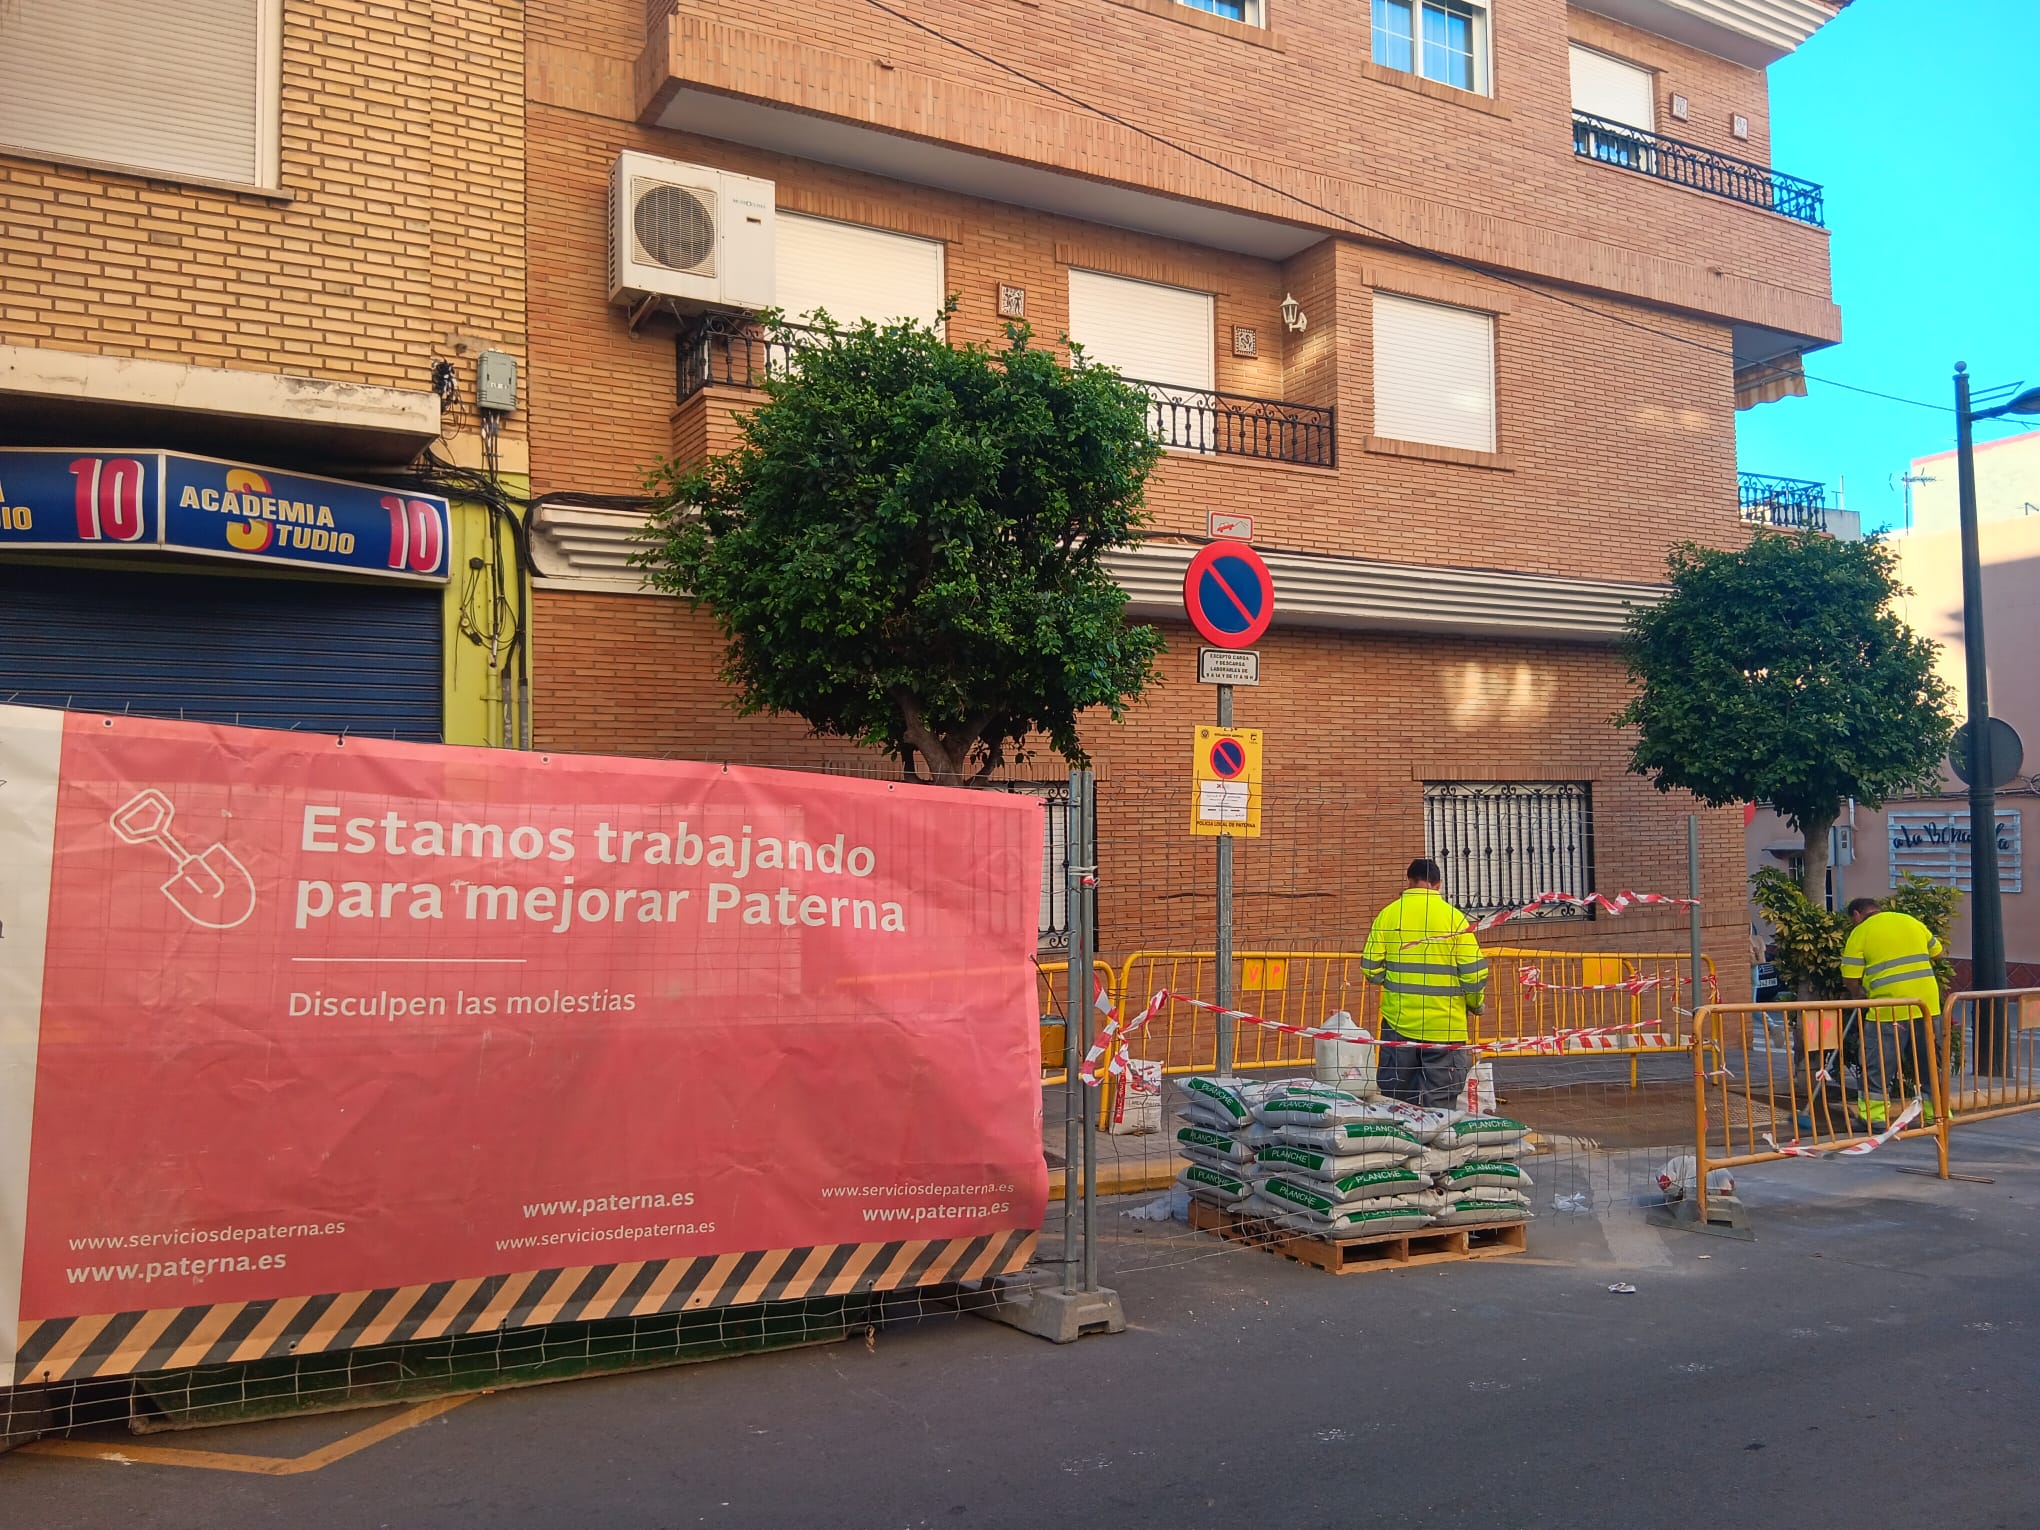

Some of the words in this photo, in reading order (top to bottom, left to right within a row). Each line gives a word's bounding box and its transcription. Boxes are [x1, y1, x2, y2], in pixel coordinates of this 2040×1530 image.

[69, 457, 144, 541] 10
[180, 486, 335, 528] ACADEMIA
[0, 506, 33, 530] IO
[380, 495, 443, 573] 10
[300, 804, 576, 862] Estamos
[594, 820, 877, 878] trabajando
[294, 876, 445, 930] para
[464, 876, 690, 934] mejorar
[706, 883, 906, 933] Paterna
[288, 992, 447, 1022] Disculpen
[456, 990, 498, 1016] las
[506, 989, 637, 1015] molestias
[1201, 1083, 1234, 1106] PLANCHE
[1278, 1101, 1315, 1110] PLANCHE
[1467, 1119, 1511, 1130] PLANCHE
[1271, 1149, 1309, 1163] PLANCHE
[818, 1182, 1015, 1198] www.serviciosdepaterna.es
[1356, 1170, 1402, 1184] PLANCHE
[521, 1191, 695, 1219] www.paterna.es
[1279, 1185, 1318, 1206] PLANCHE
[862, 1200, 1010, 1223] www.paterna.es
[69, 1219, 346, 1251] www.serviciosdepaterna.es
[495, 1220, 717, 1251] www.serviciosdepaterna.es
[66, 1251, 287, 1284] www.paterna.es
